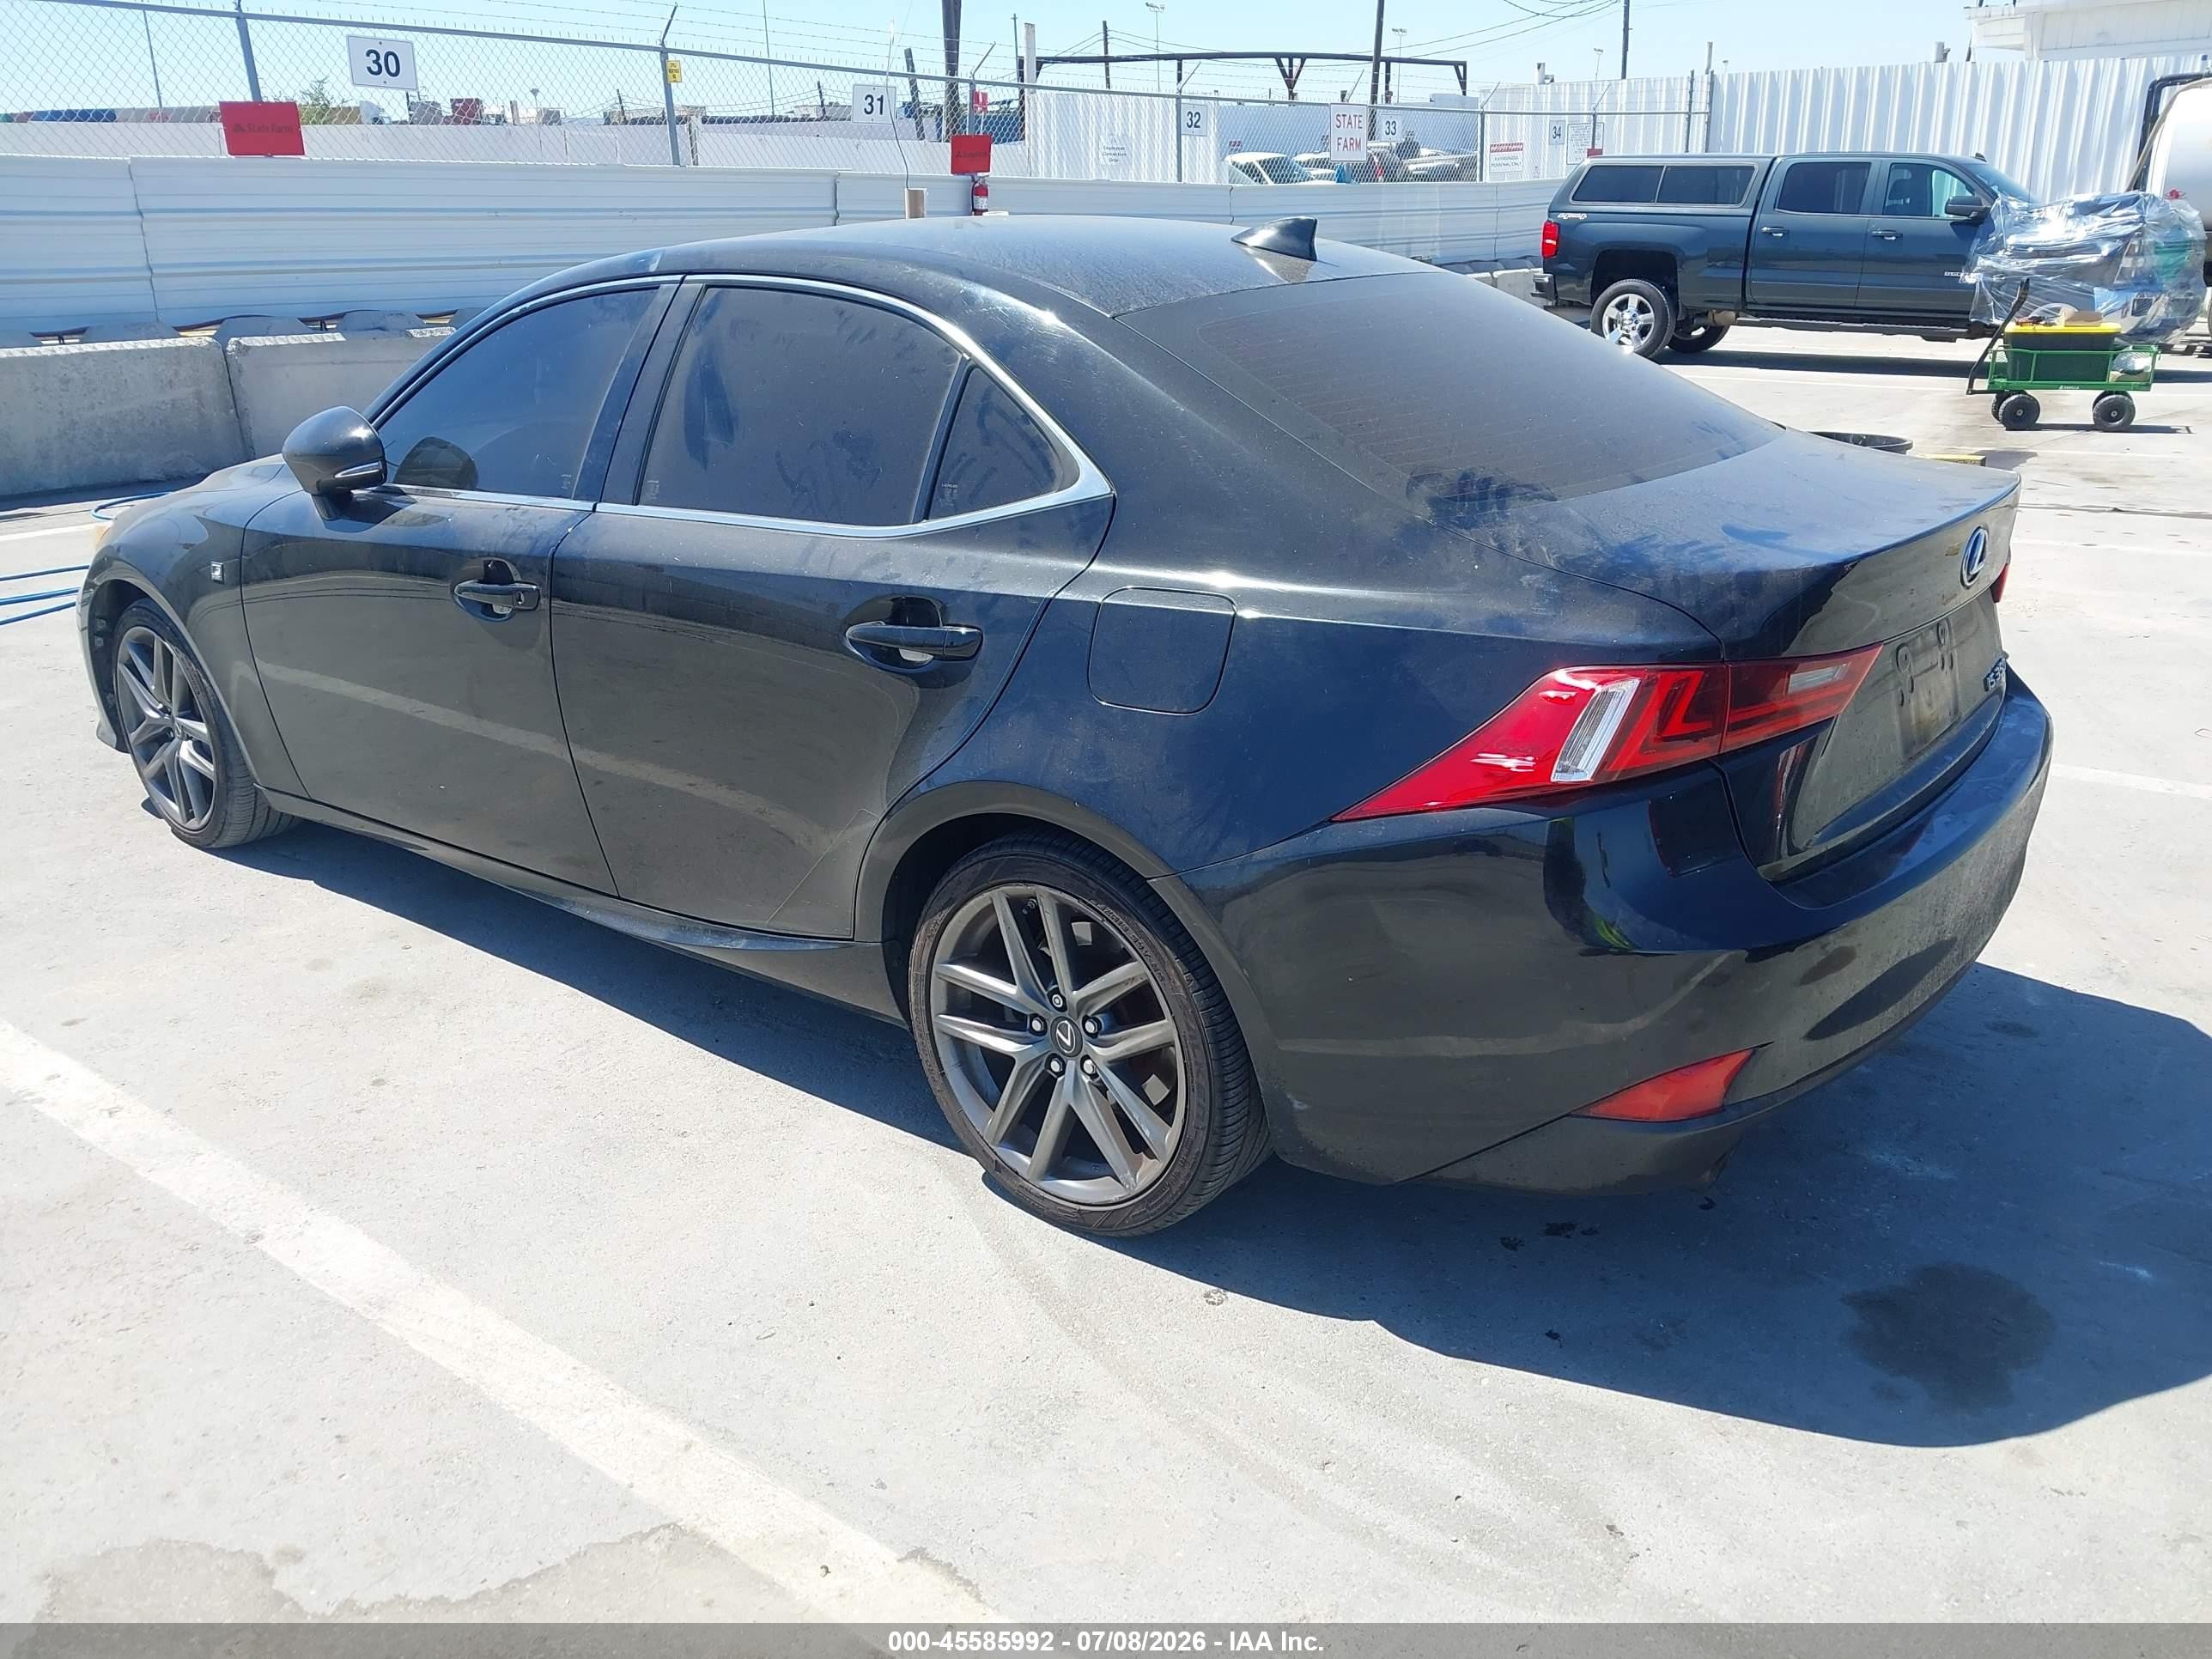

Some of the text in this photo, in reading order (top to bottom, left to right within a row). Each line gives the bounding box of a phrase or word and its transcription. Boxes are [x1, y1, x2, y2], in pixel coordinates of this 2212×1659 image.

[366, 49, 401, 77] 30
[864, 94, 884, 115] 31
[1187, 111, 1201, 129] 32
[1335, 113, 1363, 130] STATE
[1385, 120, 1397, 136] 33
[246, 124, 294, 134] State Farm
[1553, 125, 1562, 139] 34
[1337, 137, 1362, 152] FARM
